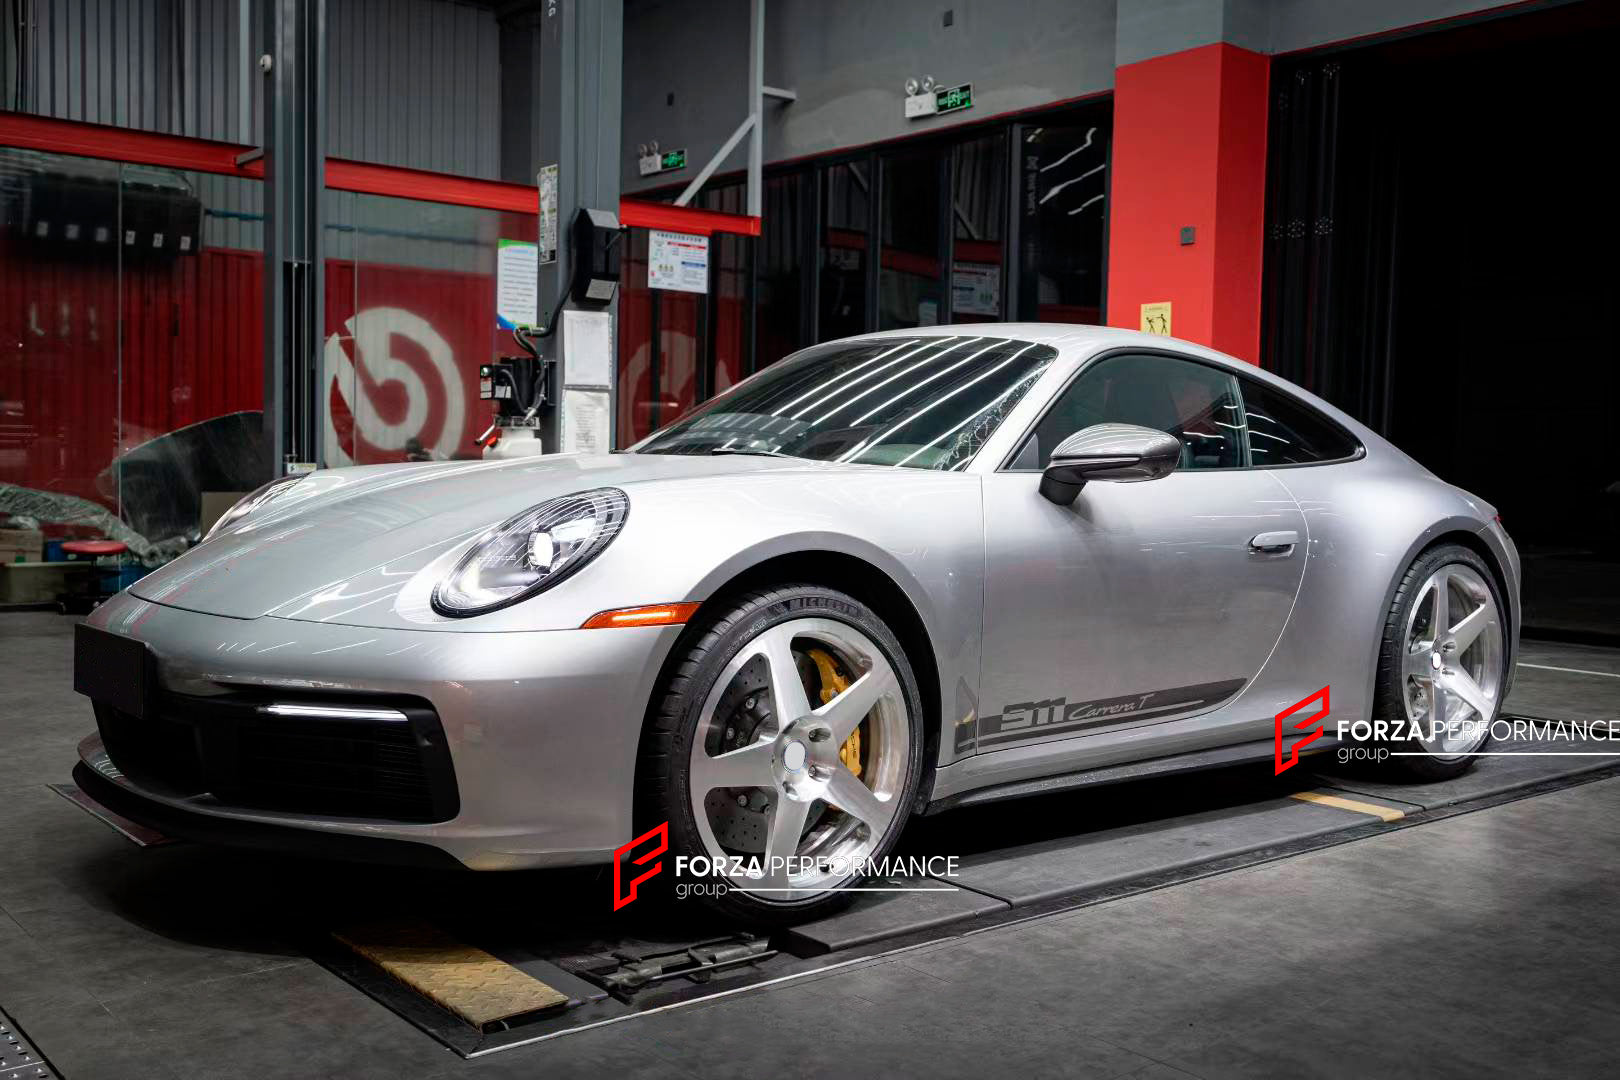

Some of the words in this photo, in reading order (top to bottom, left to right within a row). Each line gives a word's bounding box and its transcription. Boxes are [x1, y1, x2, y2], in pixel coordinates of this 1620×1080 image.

[1000, 697, 1067, 732] 911
[1068, 700, 1135, 721] Carrera
[1139, 693, 1155, 710] T
